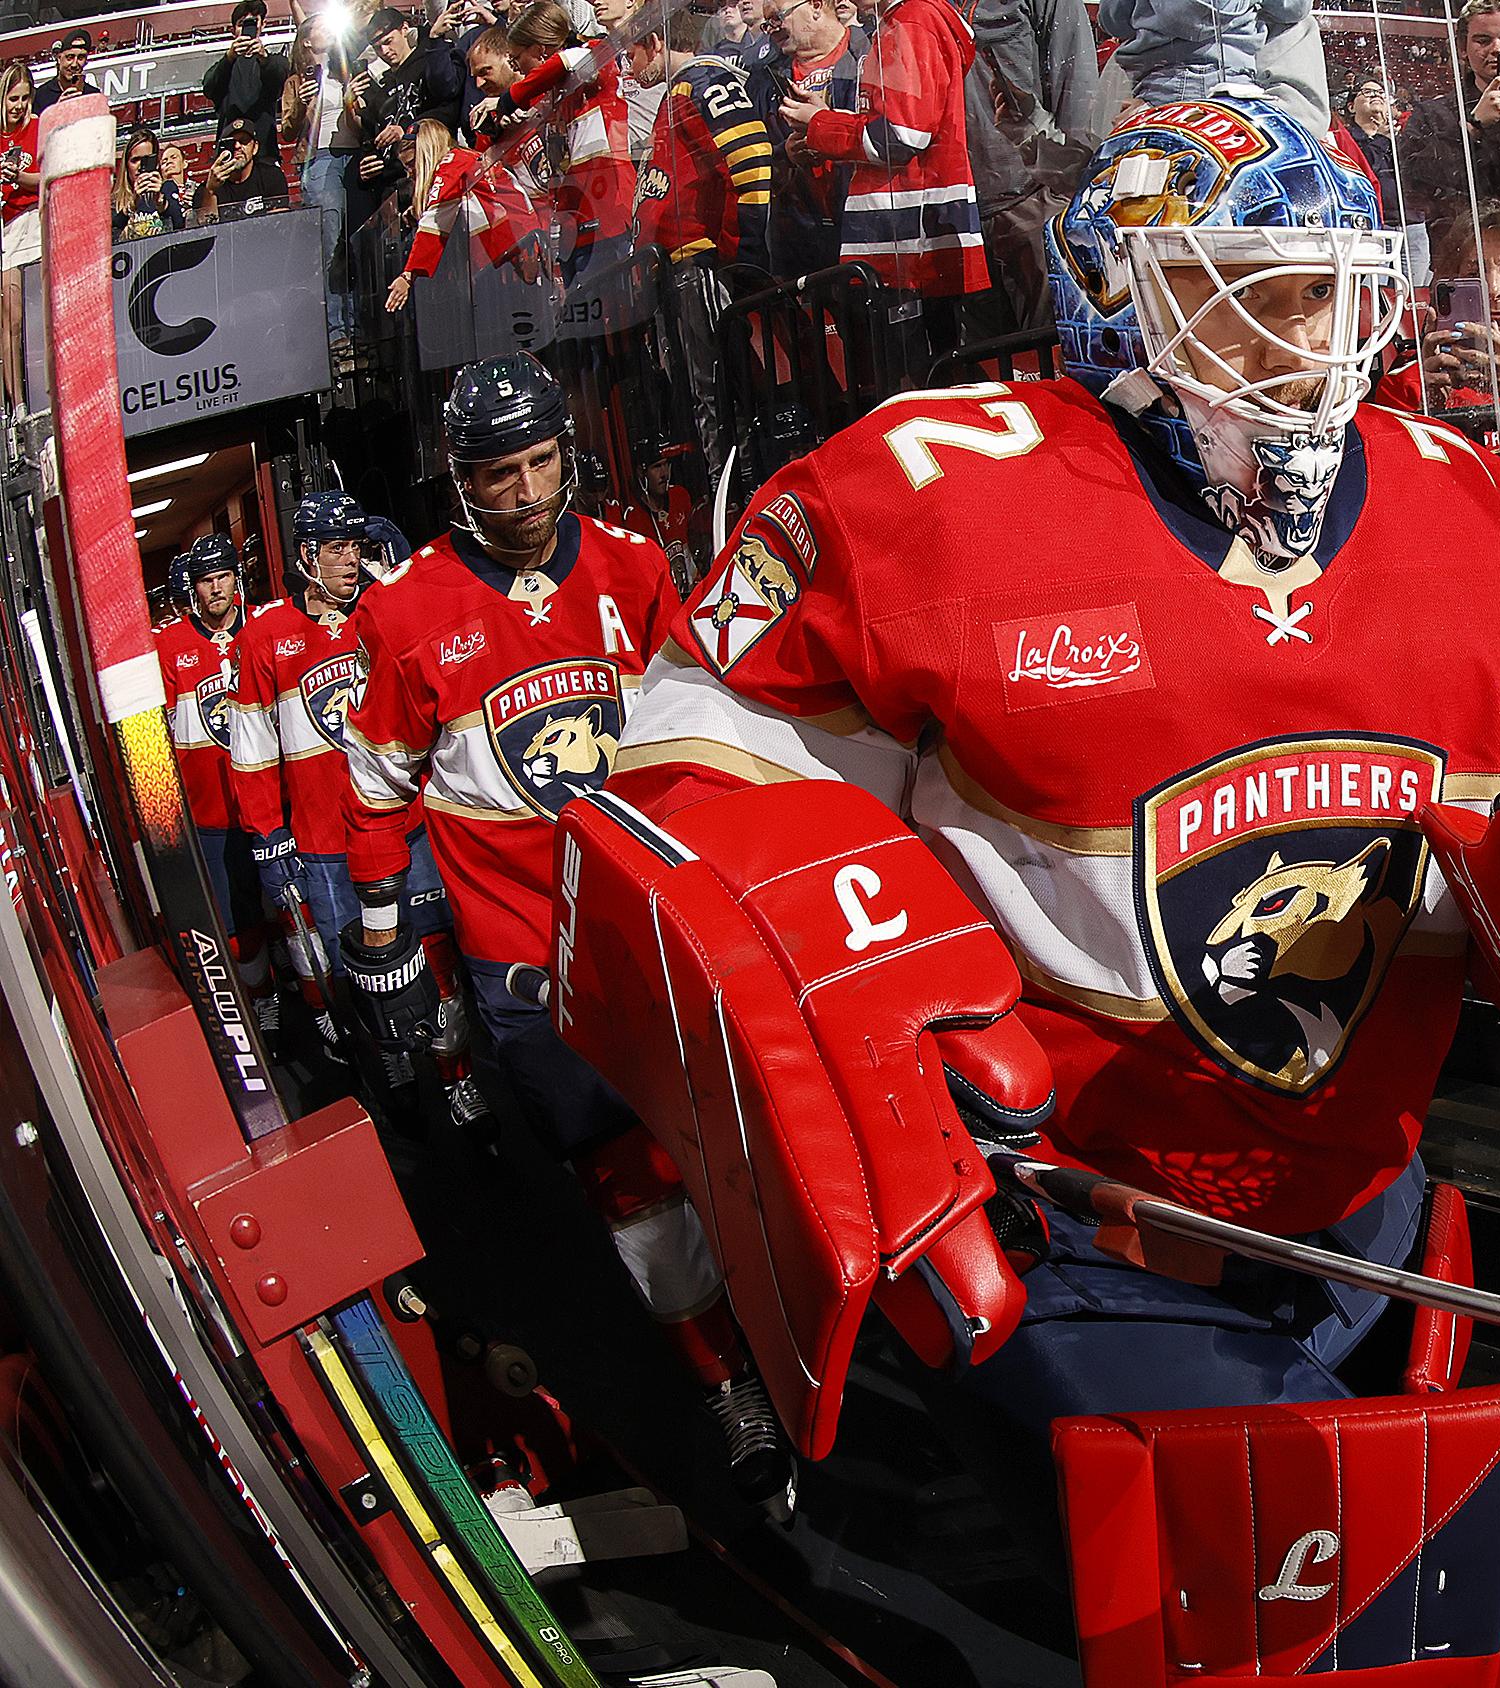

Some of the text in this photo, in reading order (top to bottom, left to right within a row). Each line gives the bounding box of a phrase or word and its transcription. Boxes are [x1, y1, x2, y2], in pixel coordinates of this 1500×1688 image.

[703, 81, 753, 119] 23
[122, 363, 239, 415] CELSIUS
[196, 391, 240, 411] LIVE FIT
[496, 378, 514, 398] 5
[770, 499, 812, 559] FLORIDA
[598, 593, 644, 656] A
[499, 669, 610, 720] PANTHERS
[1179, 762, 1420, 854] PANTHERS
[1259, 1529, 1340, 1602] L
[553, 1641, 574, 1666] PRO
